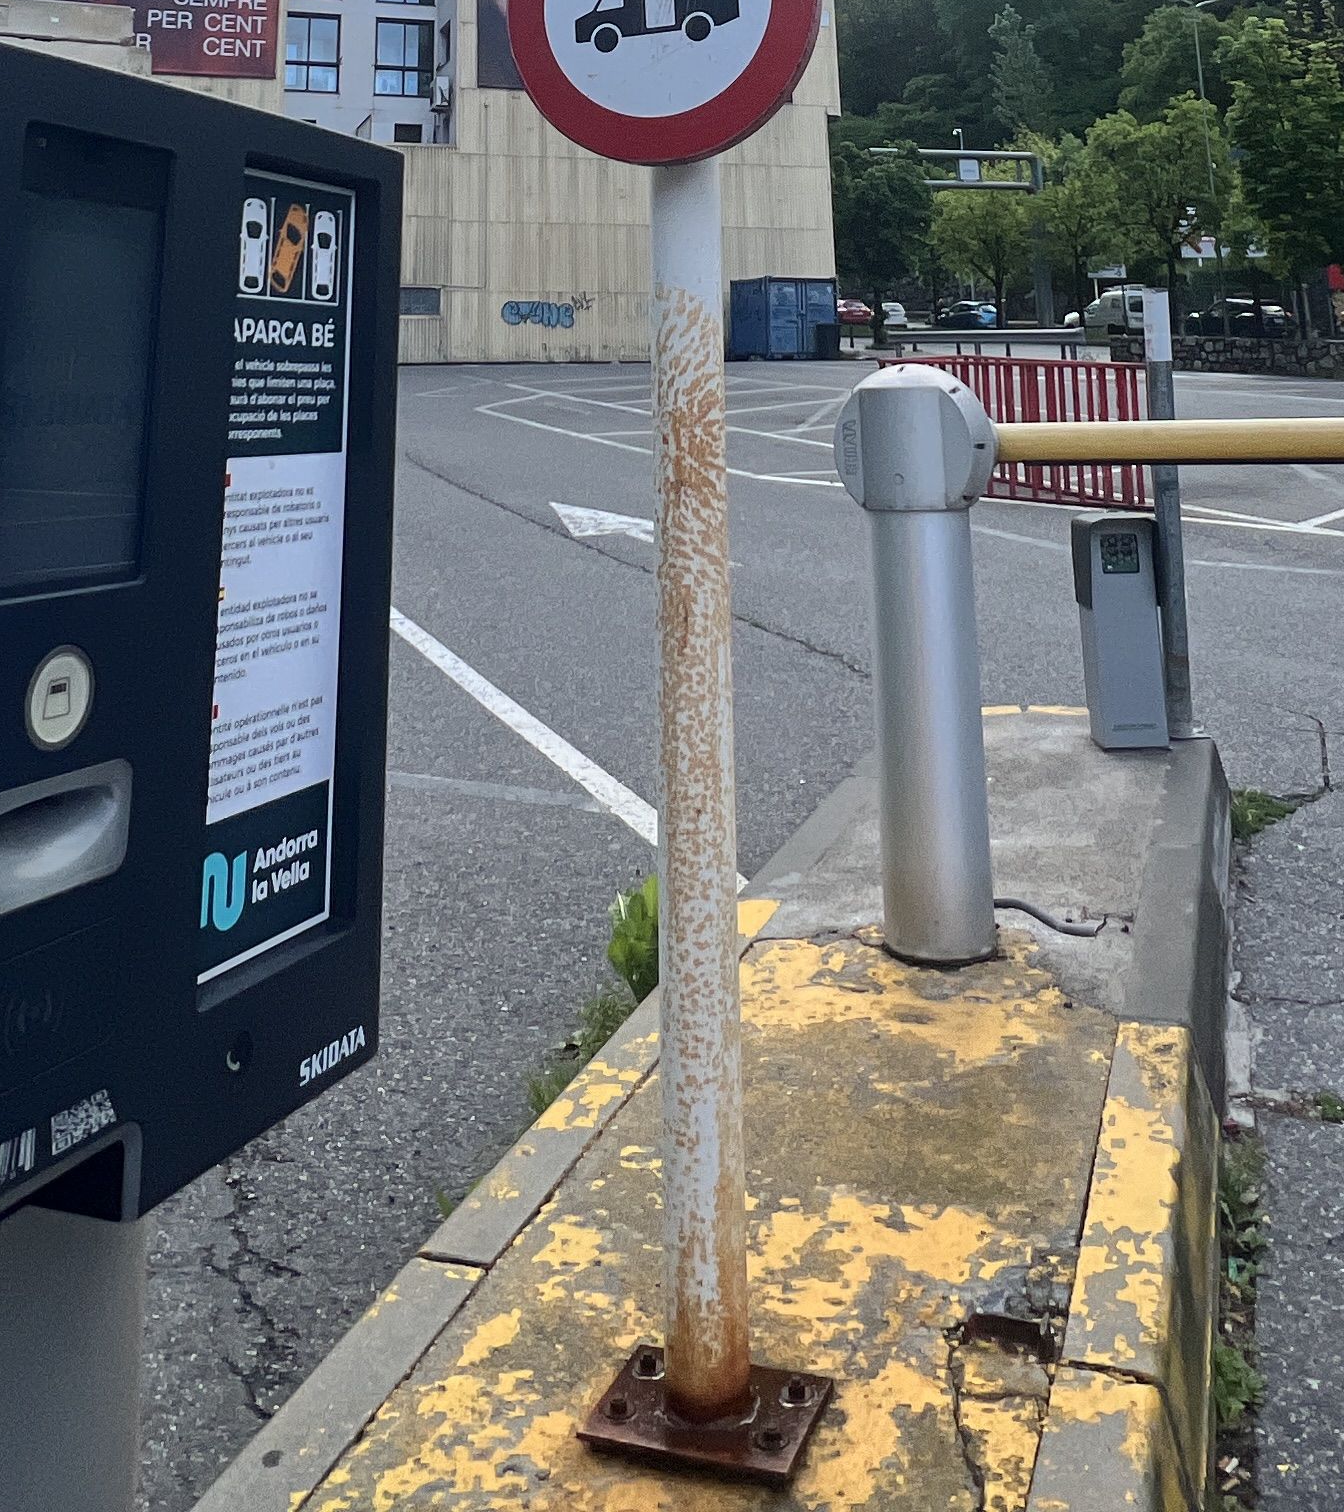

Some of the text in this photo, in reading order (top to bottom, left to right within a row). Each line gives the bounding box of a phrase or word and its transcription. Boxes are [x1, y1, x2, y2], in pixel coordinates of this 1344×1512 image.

[147, 9, 193, 30] PER
[204, 14, 267, 35] CENT
[202, 37, 267, 59] CENT
[234, 317, 335, 347] APARCA BÉ
[253, 829, 319, 873] Andorra
[251, 860, 310, 904] la Vella
[299, 1025, 366, 1087] SKIDATA
